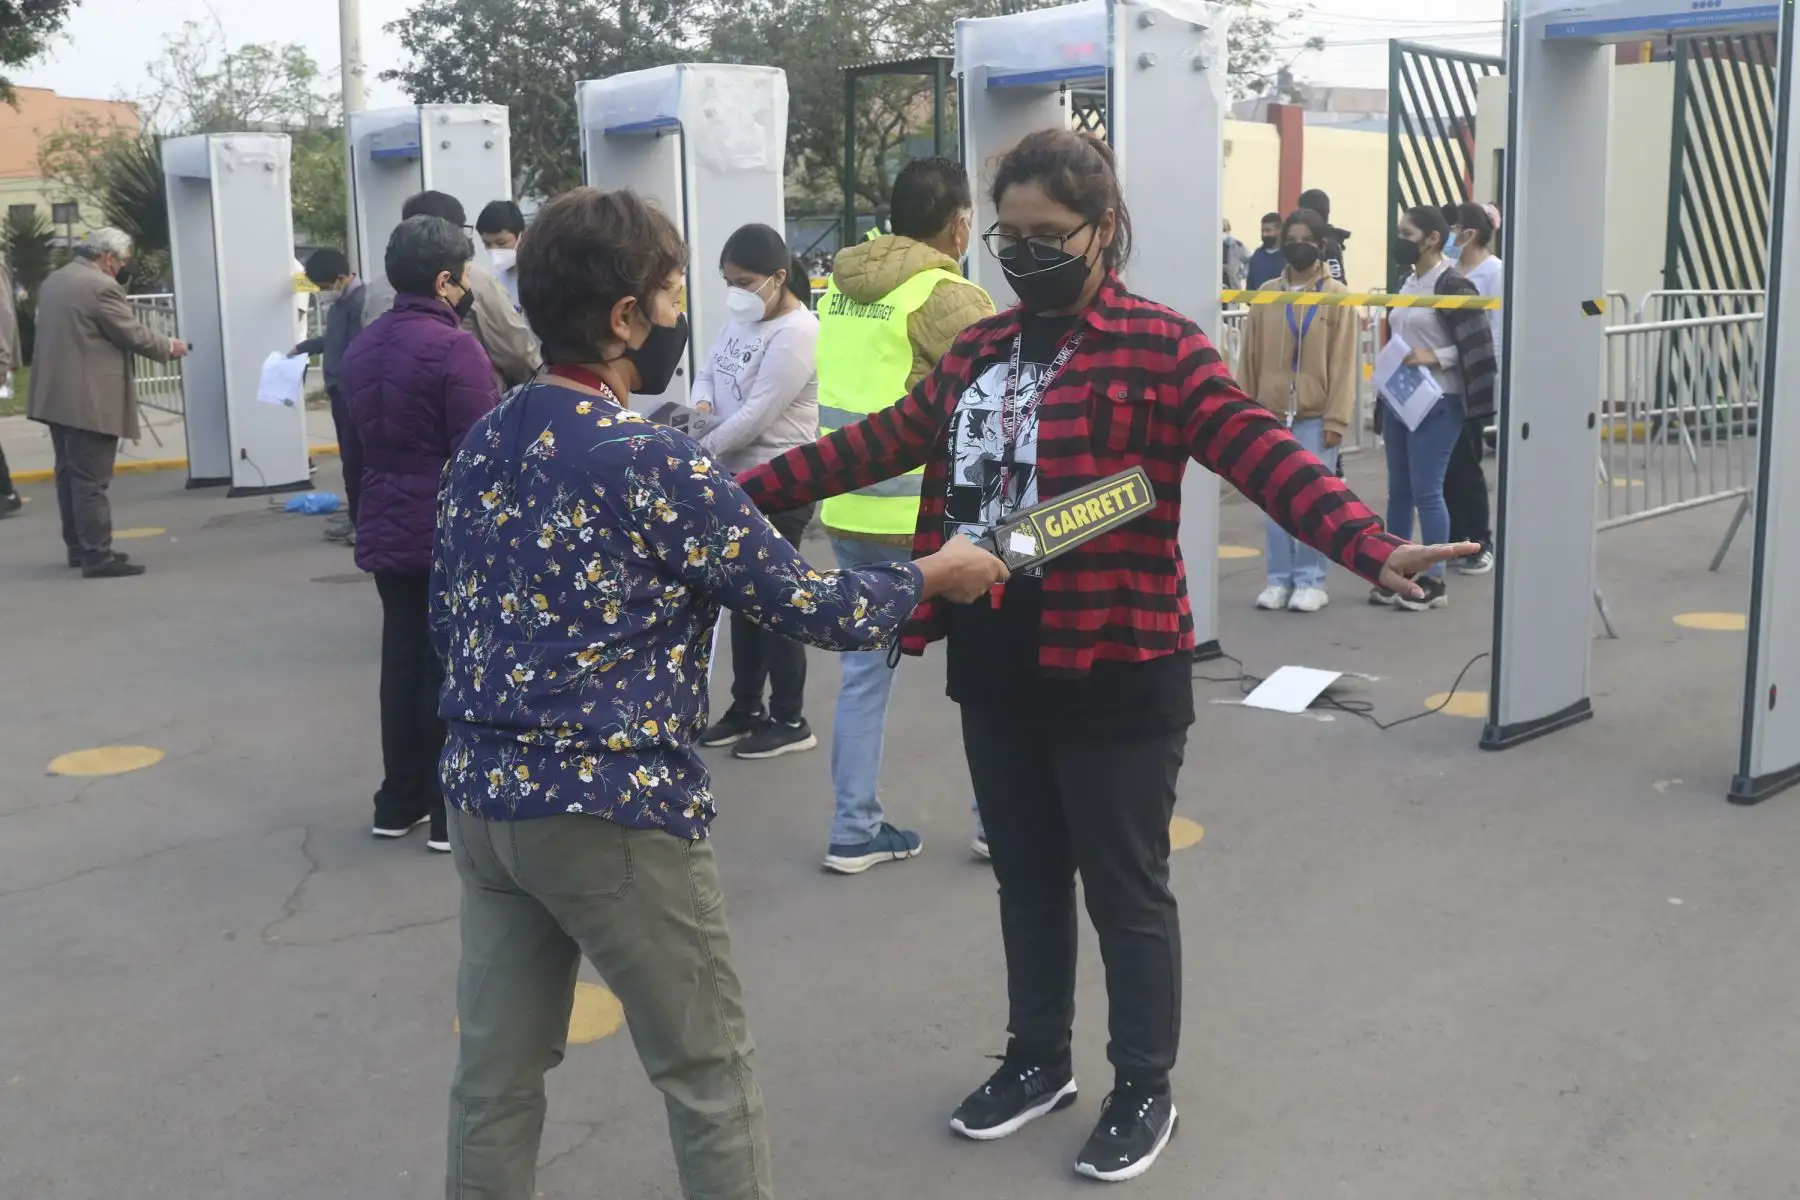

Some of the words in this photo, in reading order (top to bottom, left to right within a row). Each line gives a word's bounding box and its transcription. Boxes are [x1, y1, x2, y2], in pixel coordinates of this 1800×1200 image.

[828, 293, 849, 315] HM
[867, 304, 895, 321] ENERGY
[1045, 482, 1138, 538] GARRETT
